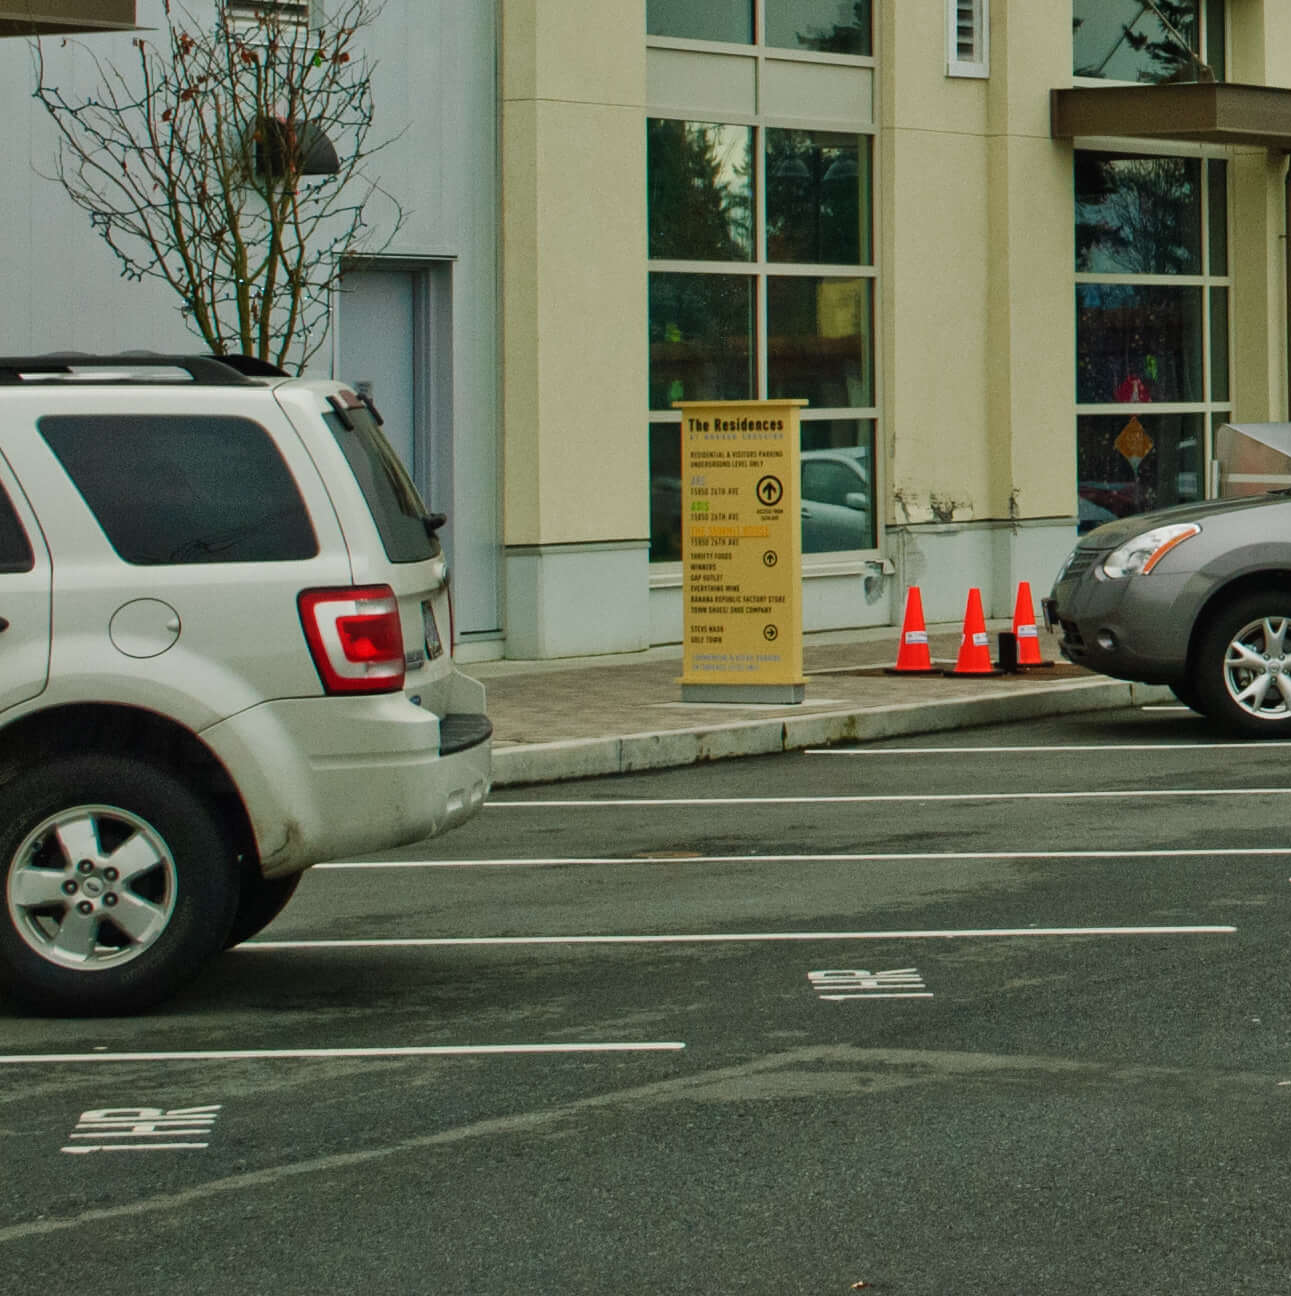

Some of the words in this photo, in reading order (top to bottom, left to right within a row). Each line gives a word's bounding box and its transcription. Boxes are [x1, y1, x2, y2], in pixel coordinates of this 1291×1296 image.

[688, 418, 709, 432] The
[714, 417, 784, 432] Residences
[728, 488, 739, 496] AVE
[728, 513, 739, 521] AVE
